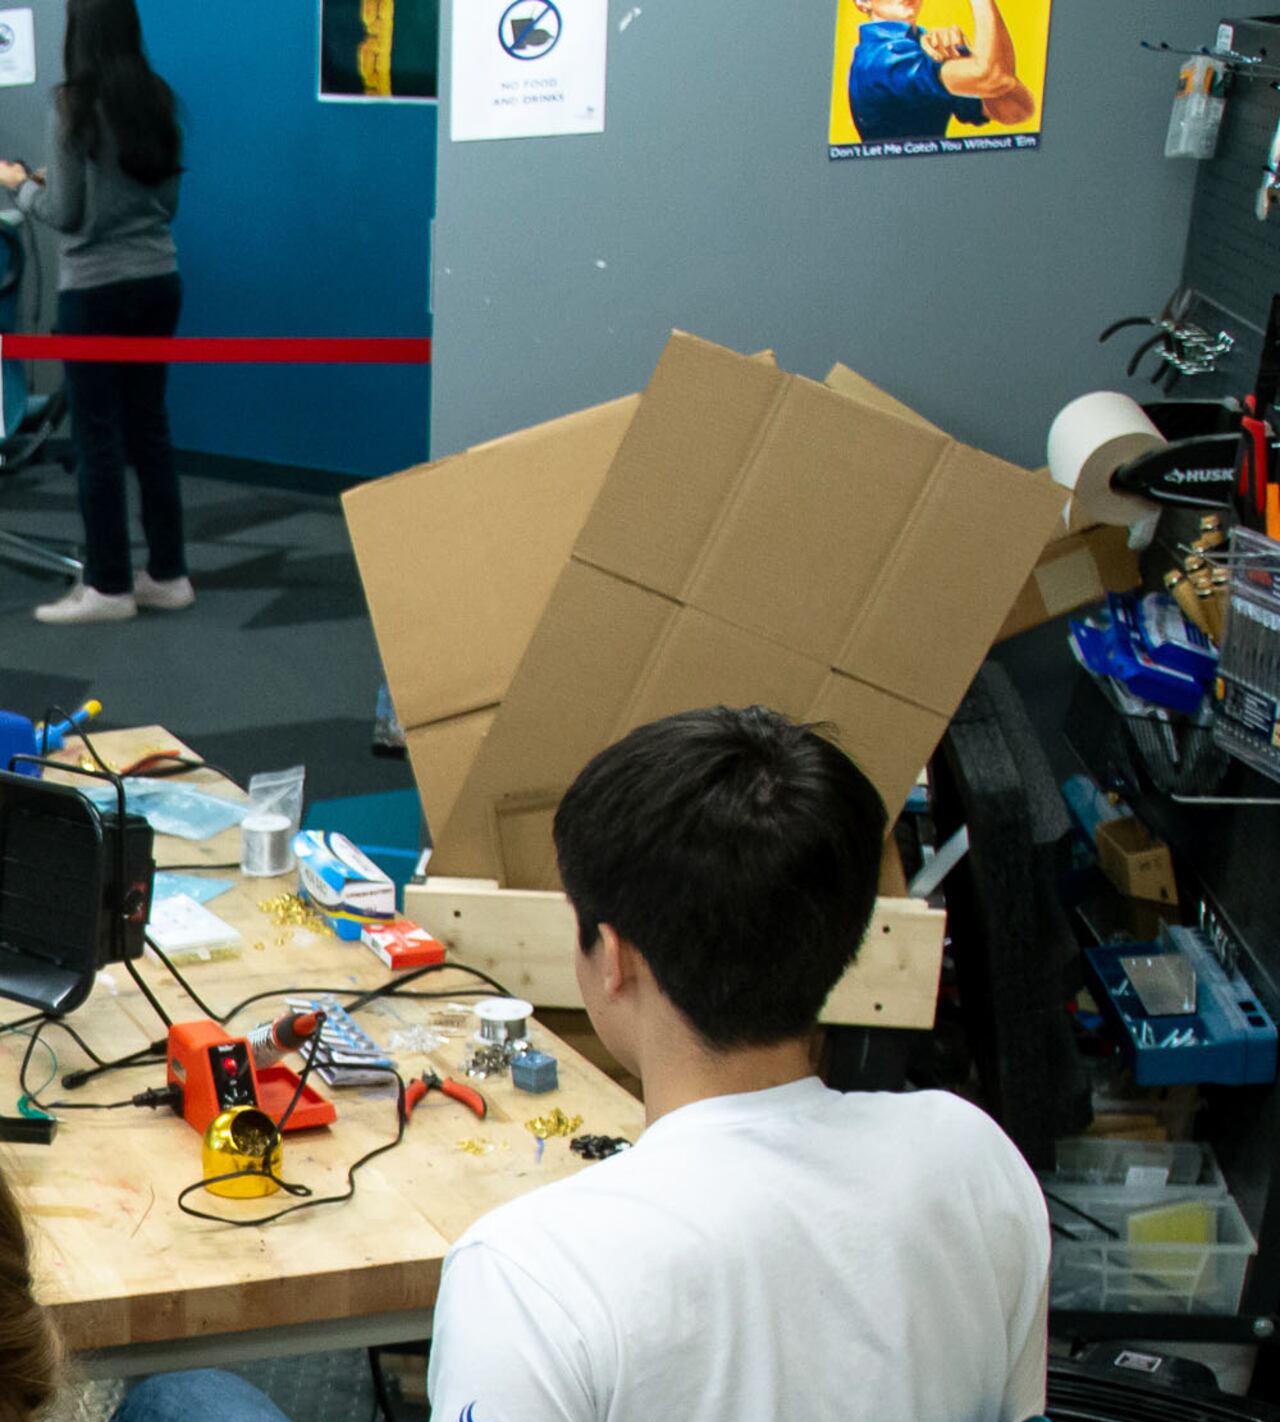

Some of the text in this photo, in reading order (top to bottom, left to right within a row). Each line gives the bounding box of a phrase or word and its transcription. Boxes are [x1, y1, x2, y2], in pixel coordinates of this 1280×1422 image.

[829, 145, 862, 159] Don't
[863, 144, 883, 157] Let
[884, 143, 902, 156] Me
[904, 141, 939, 155] Catch
[940, 139, 963, 152] You
[964, 136, 1012, 150] Without
[1186, 467, 1236, 482] HUSK
